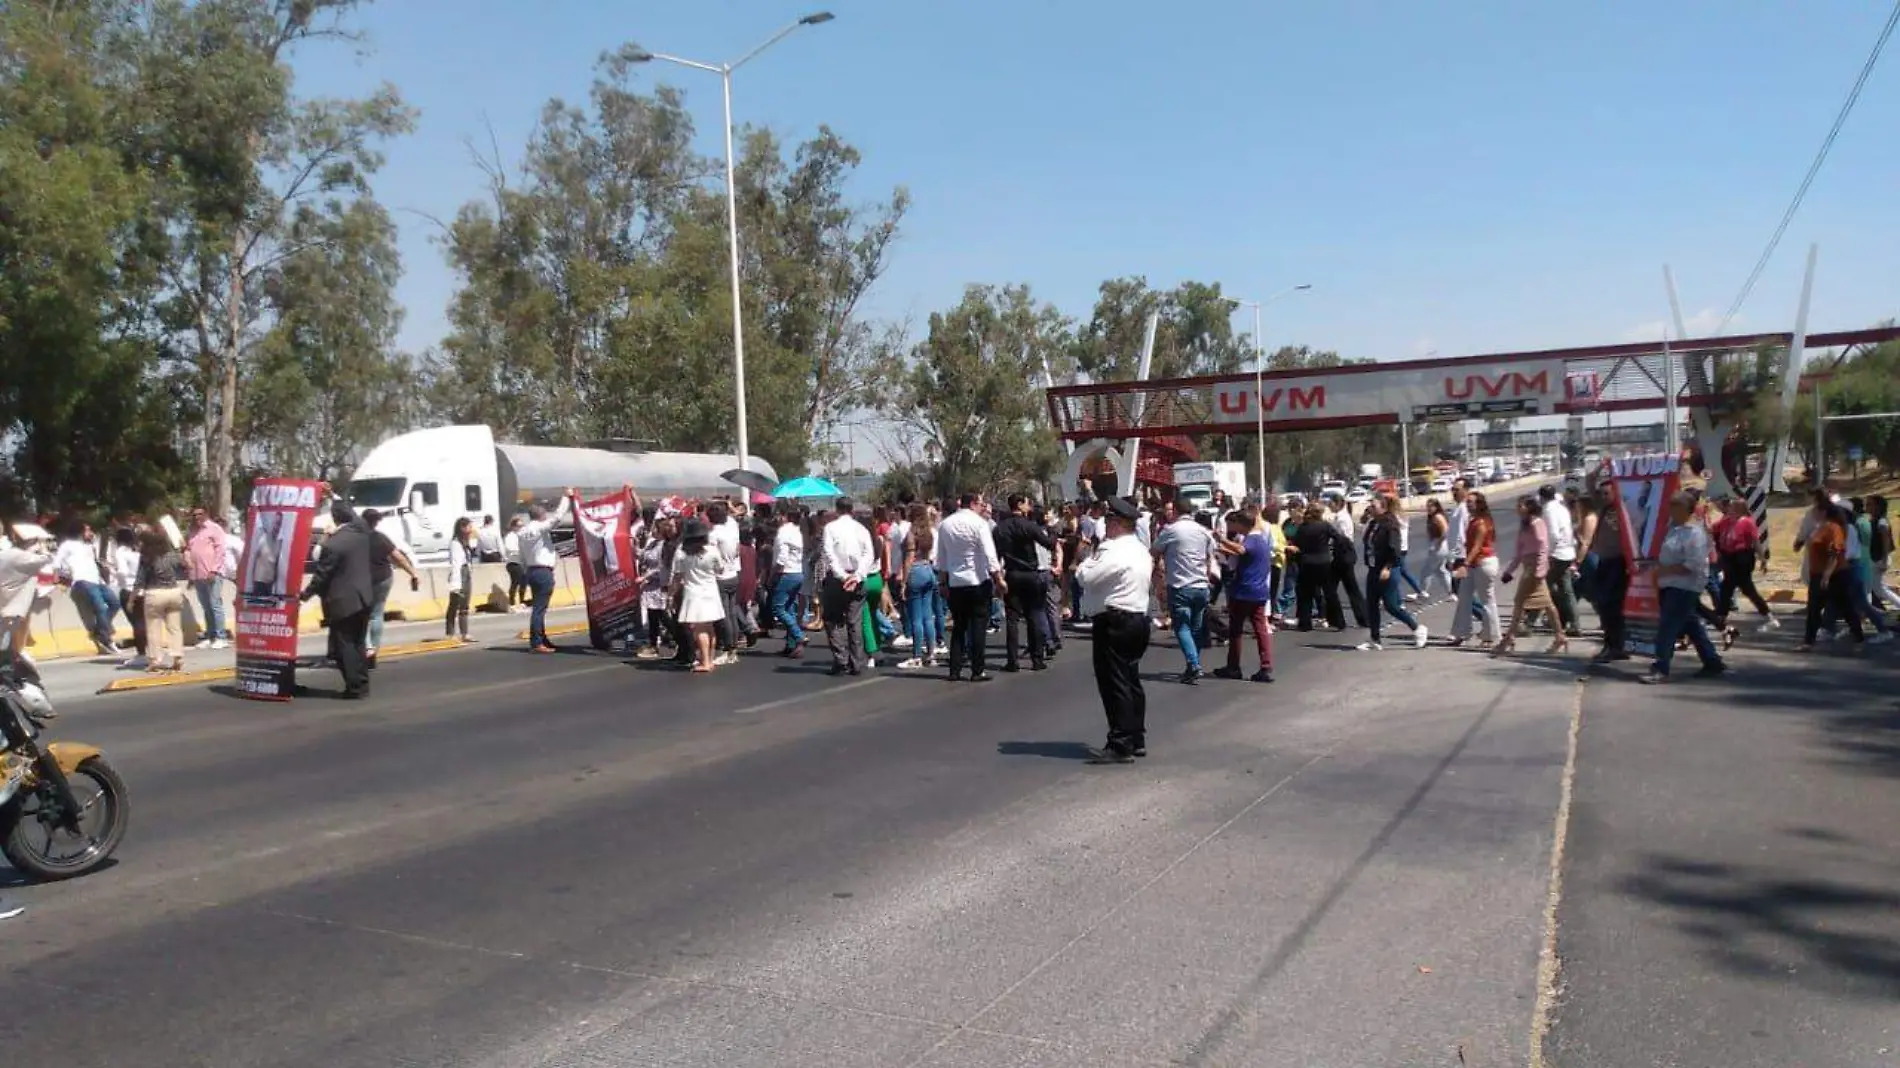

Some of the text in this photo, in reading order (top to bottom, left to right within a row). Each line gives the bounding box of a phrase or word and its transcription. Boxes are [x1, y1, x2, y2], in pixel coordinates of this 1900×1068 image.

[1445, 370, 1548, 399] UVM
[1220, 385, 1326, 413] UVM
[1611, 453, 1681, 476] AYUDA
[250, 485, 316, 508] AYUDA
